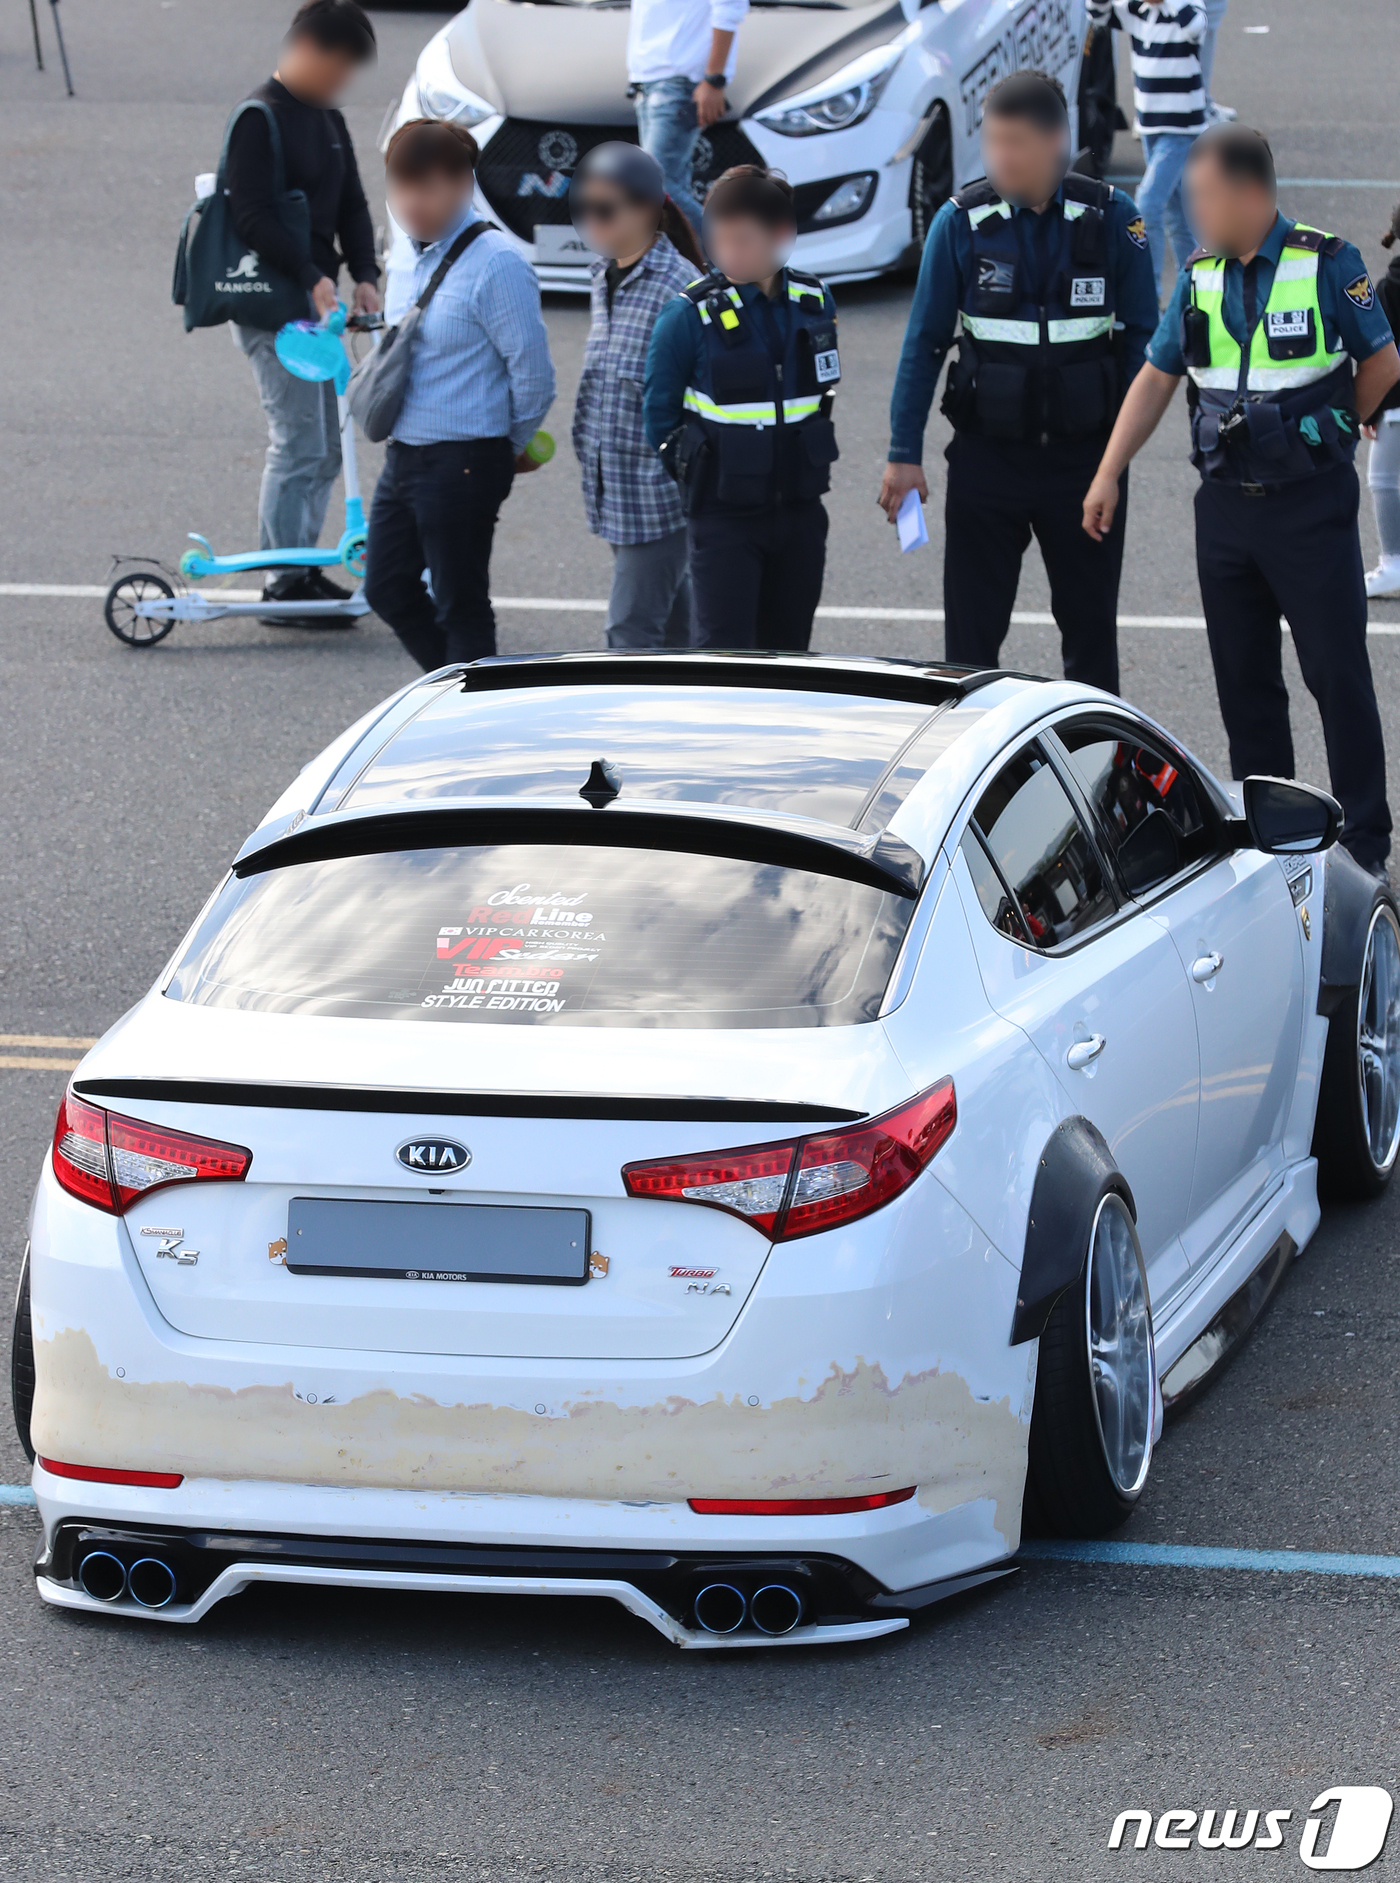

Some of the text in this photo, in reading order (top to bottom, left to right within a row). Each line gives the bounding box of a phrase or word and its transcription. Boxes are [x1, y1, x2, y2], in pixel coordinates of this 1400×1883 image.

[214, 281, 273, 293] KANGOL
[1273, 325, 1304, 333] POLICE
[487, 883, 588, 906] Scented
[437, 938, 524, 960] VIP
[421, 994, 486, 1008] STYLE
[486, 997, 566, 1013] EDITION
[409, 1145, 458, 1166] KIA
[156, 1238, 200, 1266] K5
[422, 1272, 434, 1280] KIA
[435, 1273, 467, 1281] MOTORS
